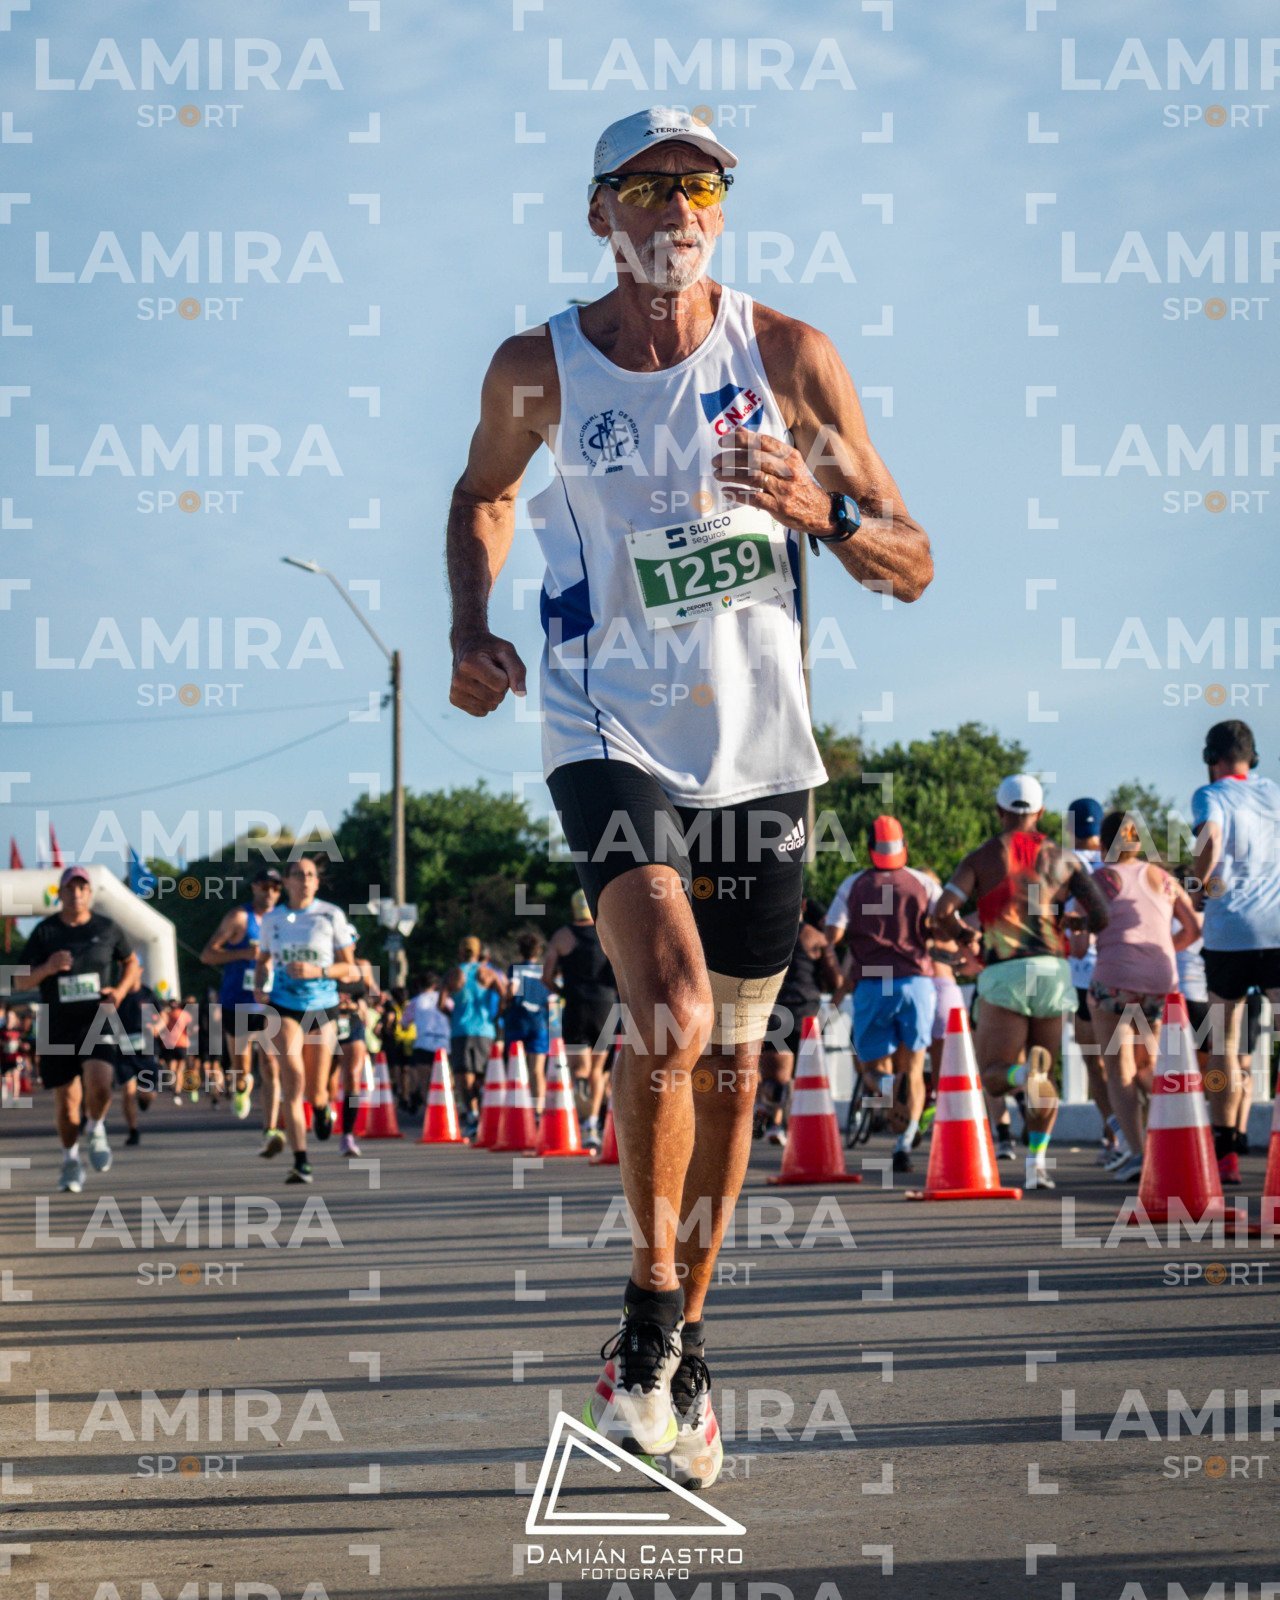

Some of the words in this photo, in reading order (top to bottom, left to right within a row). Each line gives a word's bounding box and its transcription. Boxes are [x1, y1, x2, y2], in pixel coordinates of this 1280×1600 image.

[689, 515, 731, 536] surco
[691, 529, 726, 545] seguros
[654, 540, 761, 601] 1259
[686, 602, 712, 611] DEPORTE
